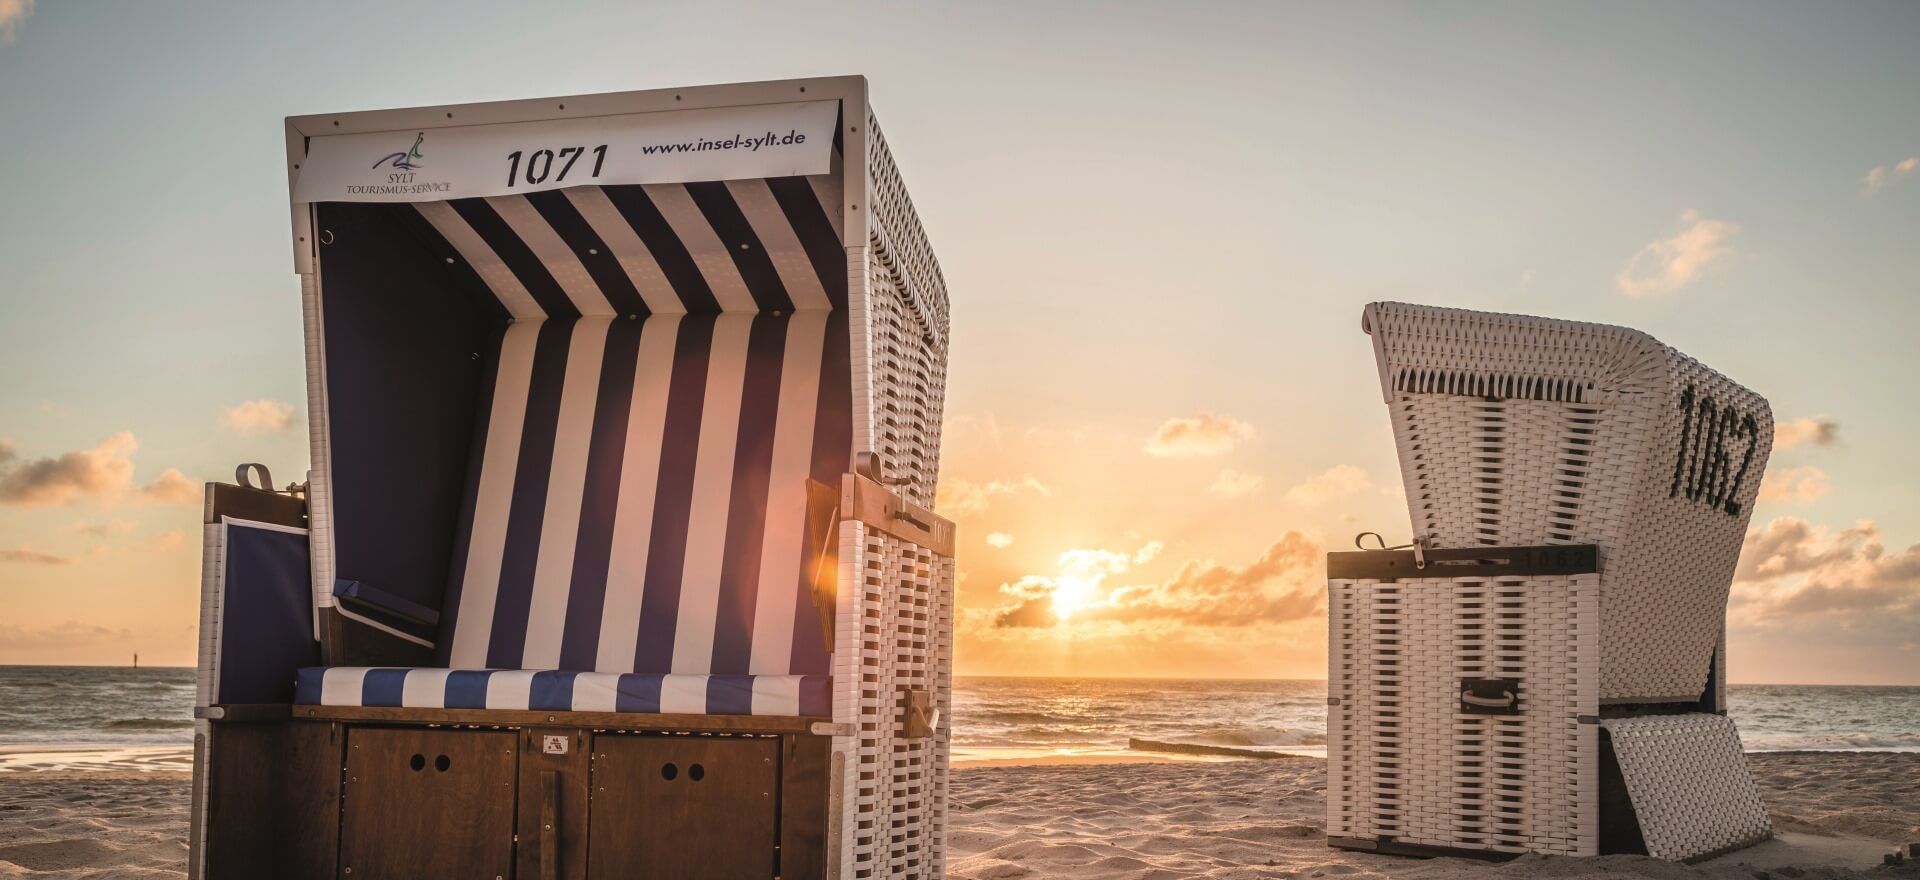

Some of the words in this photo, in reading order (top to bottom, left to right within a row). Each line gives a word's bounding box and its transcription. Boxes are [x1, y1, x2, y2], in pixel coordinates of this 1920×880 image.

[642, 129, 806, 155] www.insel-sylt.de
[387, 172, 416, 184] SYLT
[507, 144, 608, 187] 1071
[346, 181, 452, 195] TOURISMUS-SERVICE
[1669, 384, 1758, 516] 1062
